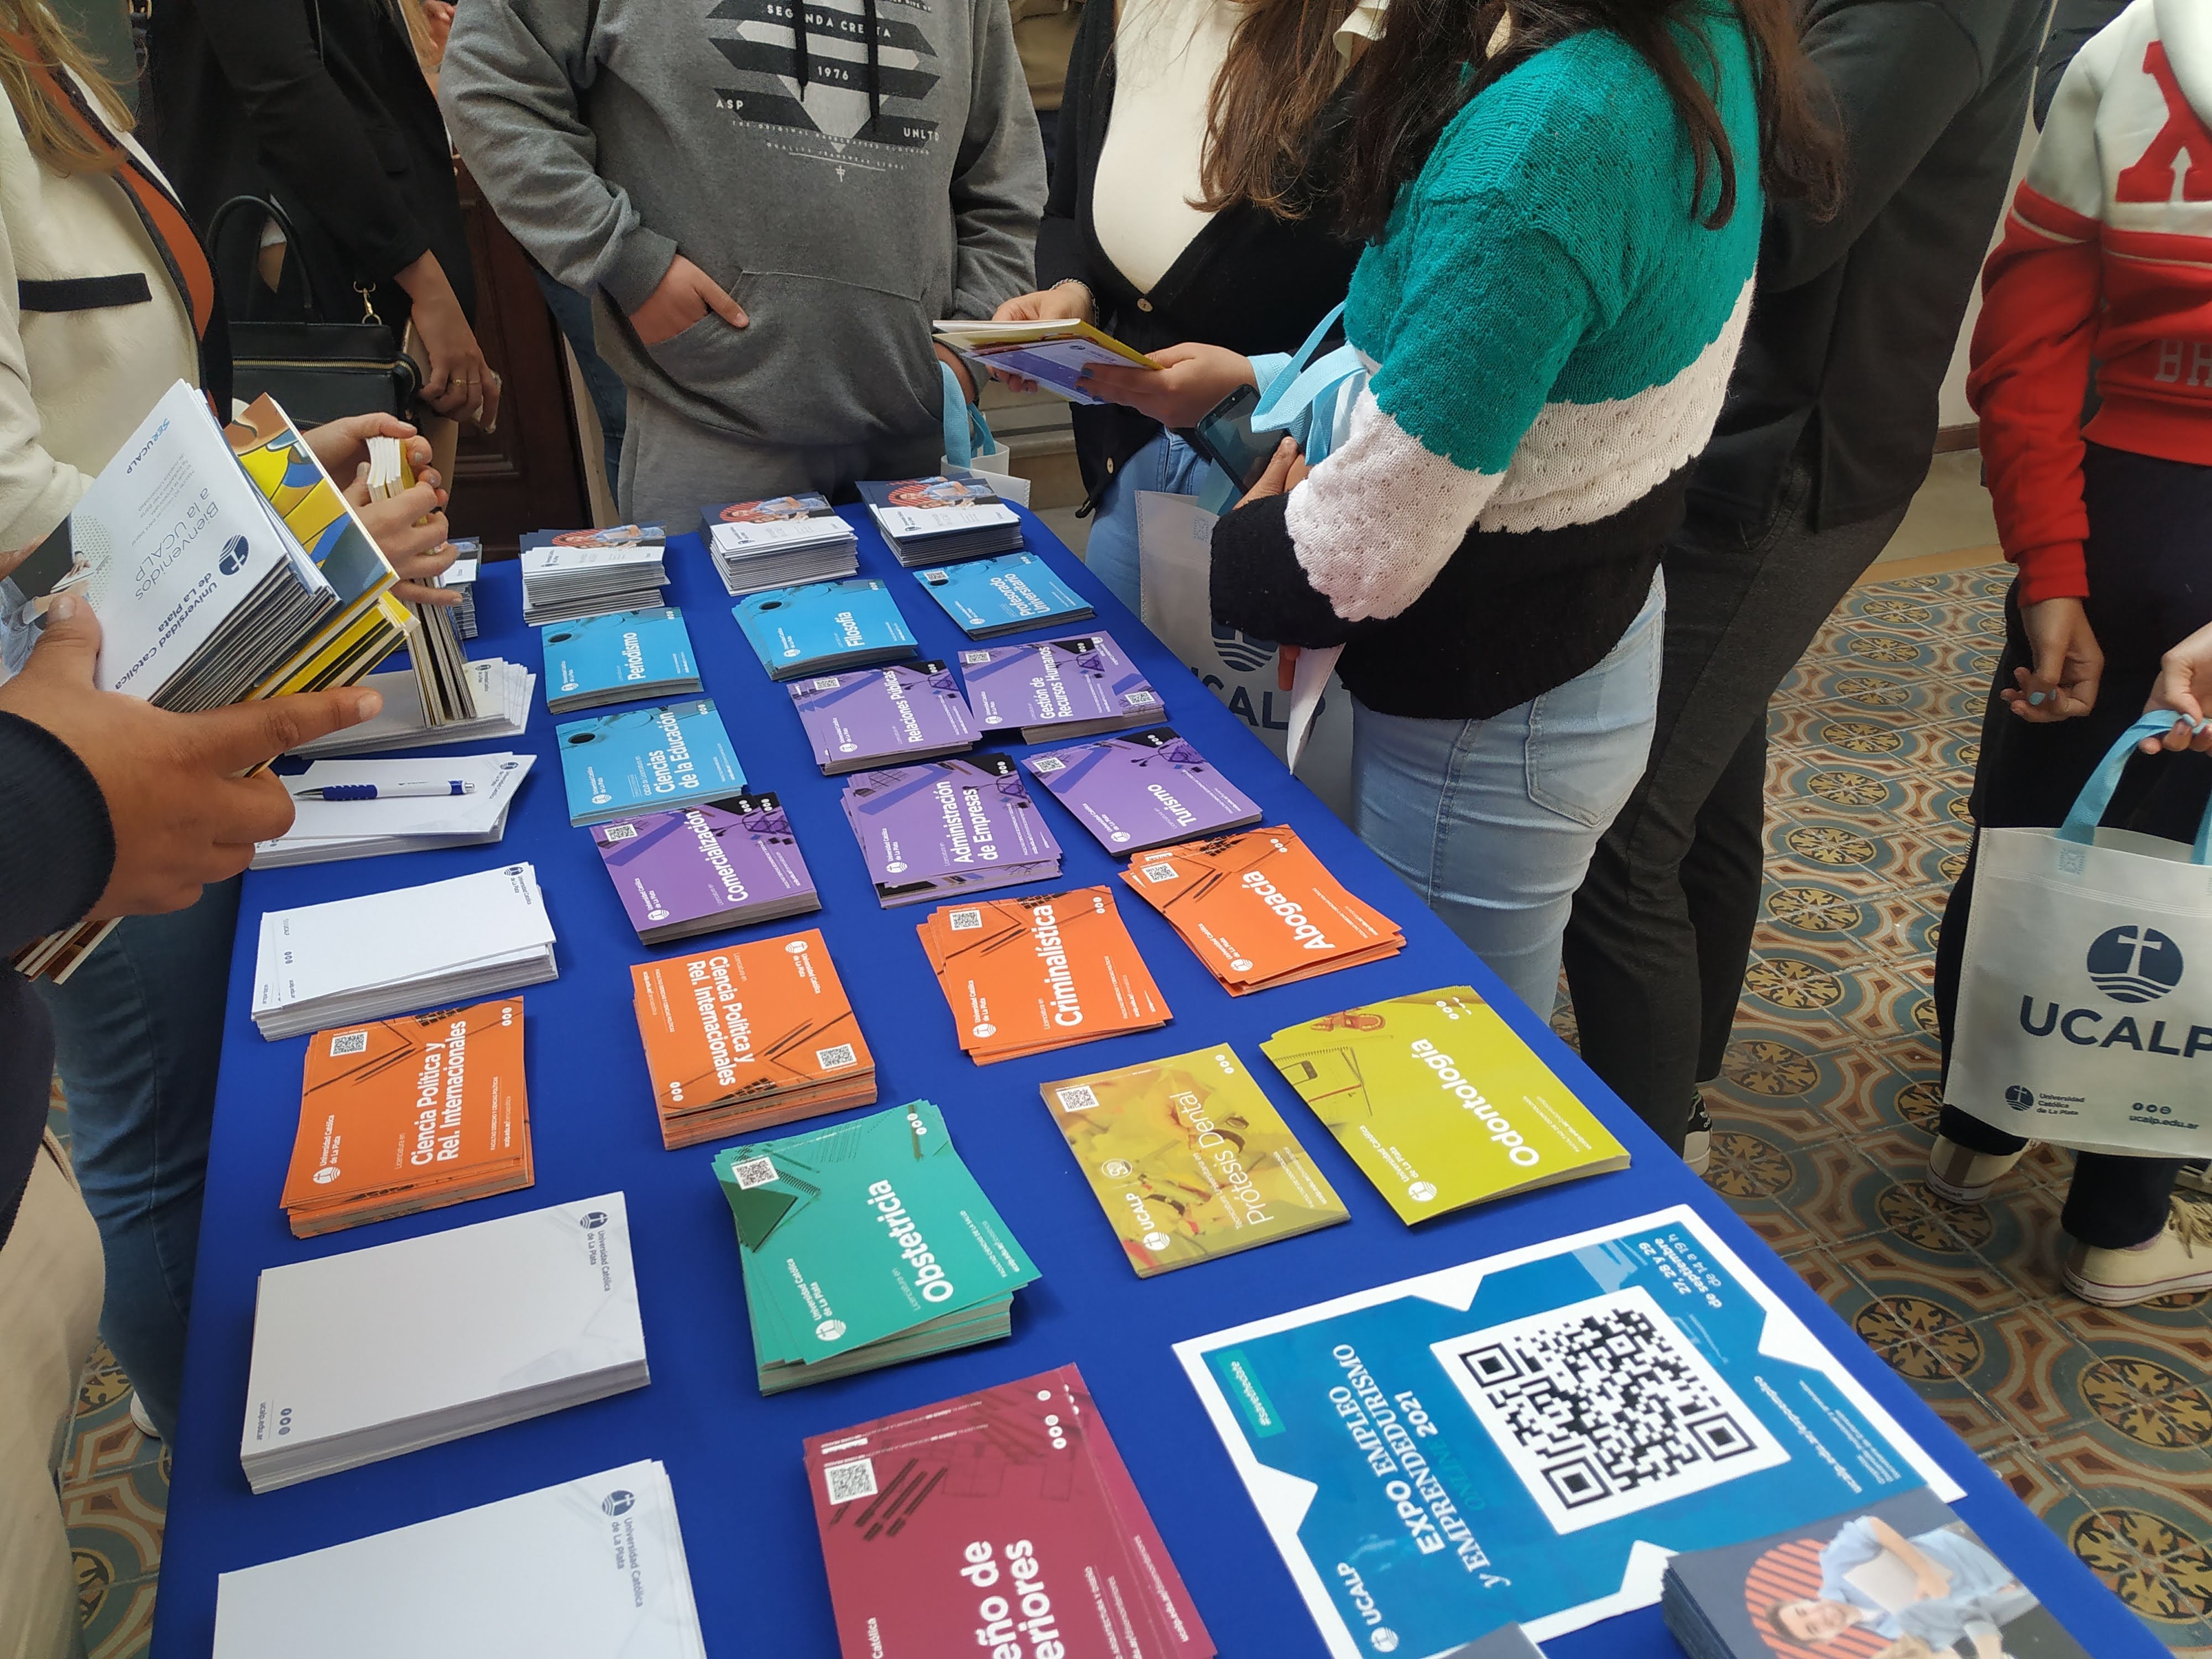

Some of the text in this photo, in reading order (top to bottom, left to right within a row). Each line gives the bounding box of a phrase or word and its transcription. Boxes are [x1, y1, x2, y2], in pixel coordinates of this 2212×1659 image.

[767, 4, 891, 38] SEGNDA CRETA
[817, 66, 849, 81] 1976
[716, 99, 744, 110] ASP
[903, 127, 940, 142] UNLTD
[131, 487, 213, 583] a la UCALP
[132, 499, 220, 604] Bienvenidos
[156, 570, 212, 635] de La Plata
[990, 577, 1036, 616] Profesorado
[1005, 573, 1050, 613] Universitario
[113, 580, 217, 691] Universidad Católica
[835, 612, 865, 647] Filosofía
[622, 632, 646, 680] Periodismo
[1039, 646, 1055, 681] Humanos
[883, 670, 924, 743] Relaciones Públicas
[1030, 677, 1056, 719] Gestión de
[1051, 682, 1073, 717] Recursos
[647, 750, 676, 793] Ciencias
[659, 712, 700, 789] de la Educación
[935, 781, 974, 863] Administración
[962, 789, 999, 860] de Empresas
[1147, 783, 1197, 827] Turismo
[684, 811, 749, 902] Comercialización
[1241, 870, 1335, 950] Abogacía
[1031, 904, 1084, 1026] Criminalística
[1198, 923, 1232, 960] Universidad Católica
[802, 953, 821, 993] Universidad Católica
[686, 961, 736, 1086] Rel. Internacionales
[709, 956, 755, 1062] Ciencia Política y
[968, 980, 980, 1023] Universidad Católica
[2020, 994, 2212, 1058] UCALP
[411, 1042, 446, 1166] Ciencia Política y
[437, 1020, 467, 1162] Rel. Internacionales
[1411, 1038, 1540, 1167] Odontología
[2038, 1100, 2069, 1108] Católica
[2039, 1093, 2085, 1103] Universidad
[320, 1115, 335, 1166] Universidad Católica
[2129, 1115, 2199, 1130] ucalp.edu.ar
[395, 1141, 404, 1169] Licenciatura
[1170, 1091, 1274, 1225] Prótesis Dental
[1359, 1125, 1409, 1181] Universidad Católica
[1389, 1146, 1419, 1178] de La Plata
[1125, 1192, 1155, 1231] UCALP
[587, 1232, 596, 1240] de
[589, 1250, 598, 1265] Plata
[867, 1179, 953, 1302] Obstetricia
[1639, 1242, 1657, 1256] 29
[1668, 1233, 1679, 1243] h
[1674, 1243, 1689, 1254] 19
[598, 1230, 611, 1292] Universidad Católica
[1655, 1238, 1722, 1308] de septiembre
[1658, 1264, 1677, 1279] 28
[1693, 1262, 1708, 1273] 14
[1706, 1273, 1721, 1286] de
[786, 1258, 822, 1320] Universidad Católica
[810, 1282, 832, 1316] de La Plata
[1672, 1277, 1692, 1294] 27,
[1230, 1360, 1274, 1428] #savethedate
[1394, 1390, 1438, 1438] 2021
[257, 1402, 267, 1441] ucalp.edu.ar
[1752, 1374, 1863, 1494] ucalp.edu.ar/expoempleo
[1329, 1385, 1446, 1554] EXPO EMPLEO
[1333, 1344, 1512, 1589] y EMPRENDEDURISMO
[1428, 1438, 1486, 1511] ONLINE
[611, 1521, 625, 1569] de La Plata
[624, 1517, 643, 1608] Universidad Católica
[960, 1540, 1000, 1588] de
[1337, 1562, 1384, 1629] UCALP
[866, 1616, 884, 1659] Católica
